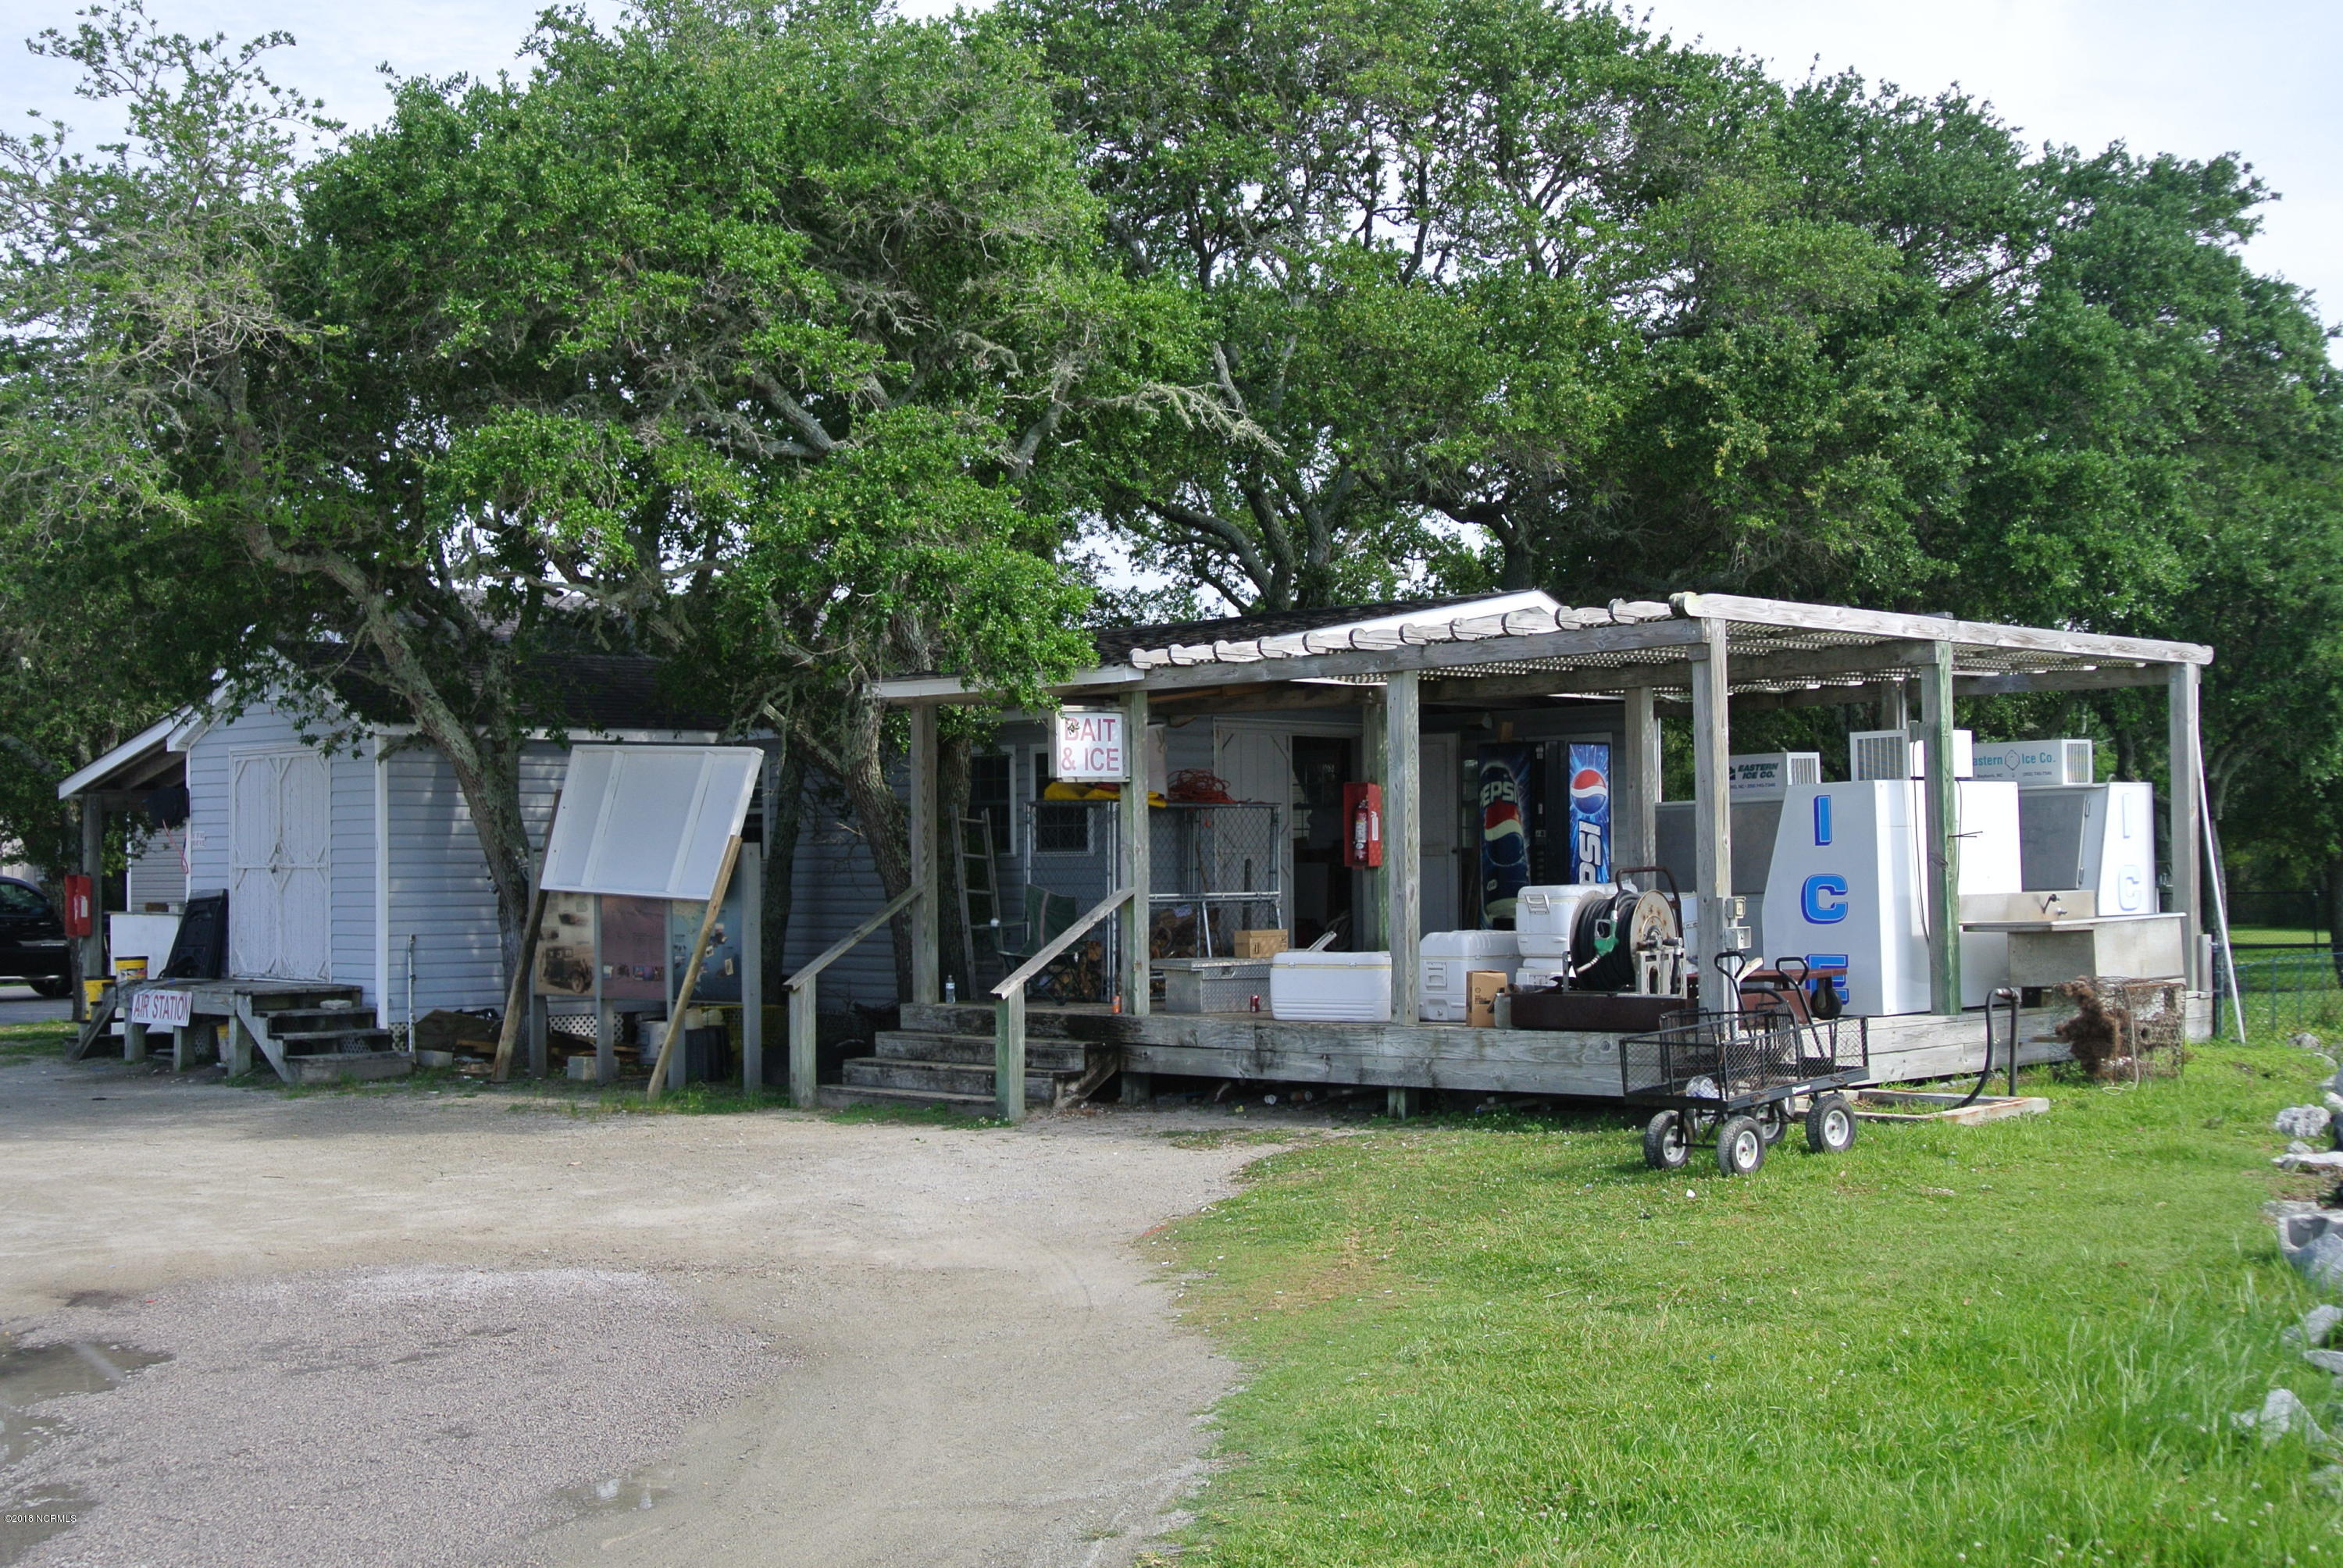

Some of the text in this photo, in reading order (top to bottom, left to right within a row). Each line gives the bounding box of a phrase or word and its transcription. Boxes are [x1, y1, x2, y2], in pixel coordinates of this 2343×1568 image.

[1065, 718, 1116, 742] BAIT
[1061, 747, 1120, 772] & ICE
[1738, 762, 1779, 772] EASTERN
[1974, 752, 2056, 766] astern Ice Co.
[1742, 772, 1758, 780] ICE
[1579, 821, 1601, 885] PSI
[2118, 793, 2142, 911] IC
[1801, 795, 1849, 1005] ICE
[134, 993, 191, 1021] AIR STATION
